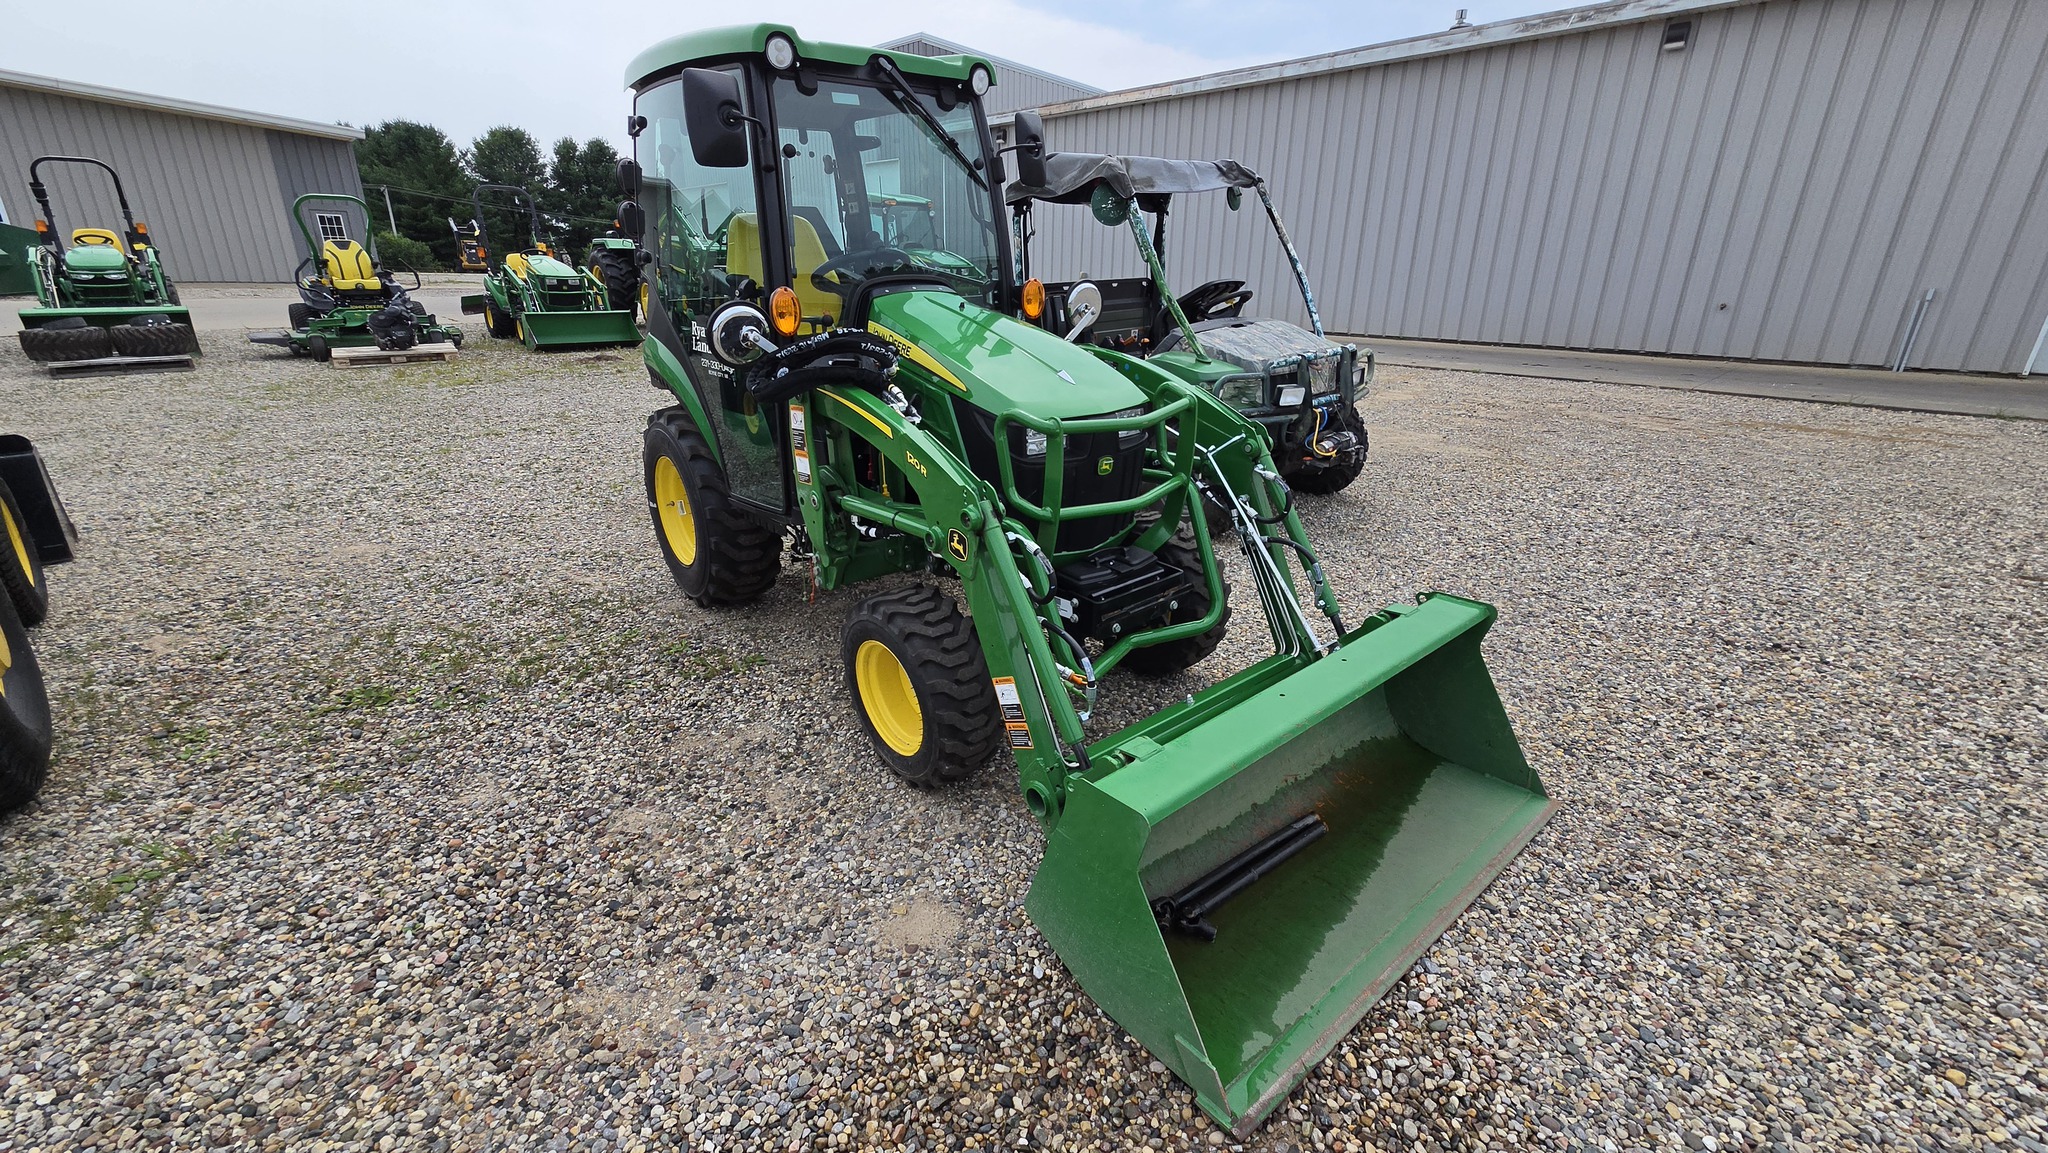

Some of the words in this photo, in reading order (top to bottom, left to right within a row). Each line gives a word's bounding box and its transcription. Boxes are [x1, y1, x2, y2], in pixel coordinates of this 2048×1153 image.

[691, 320, 706, 339] Rya
[889, 334, 912, 357] DEERE
[906, 450, 920, 470] 120
[920, 465, 928, 478] R
